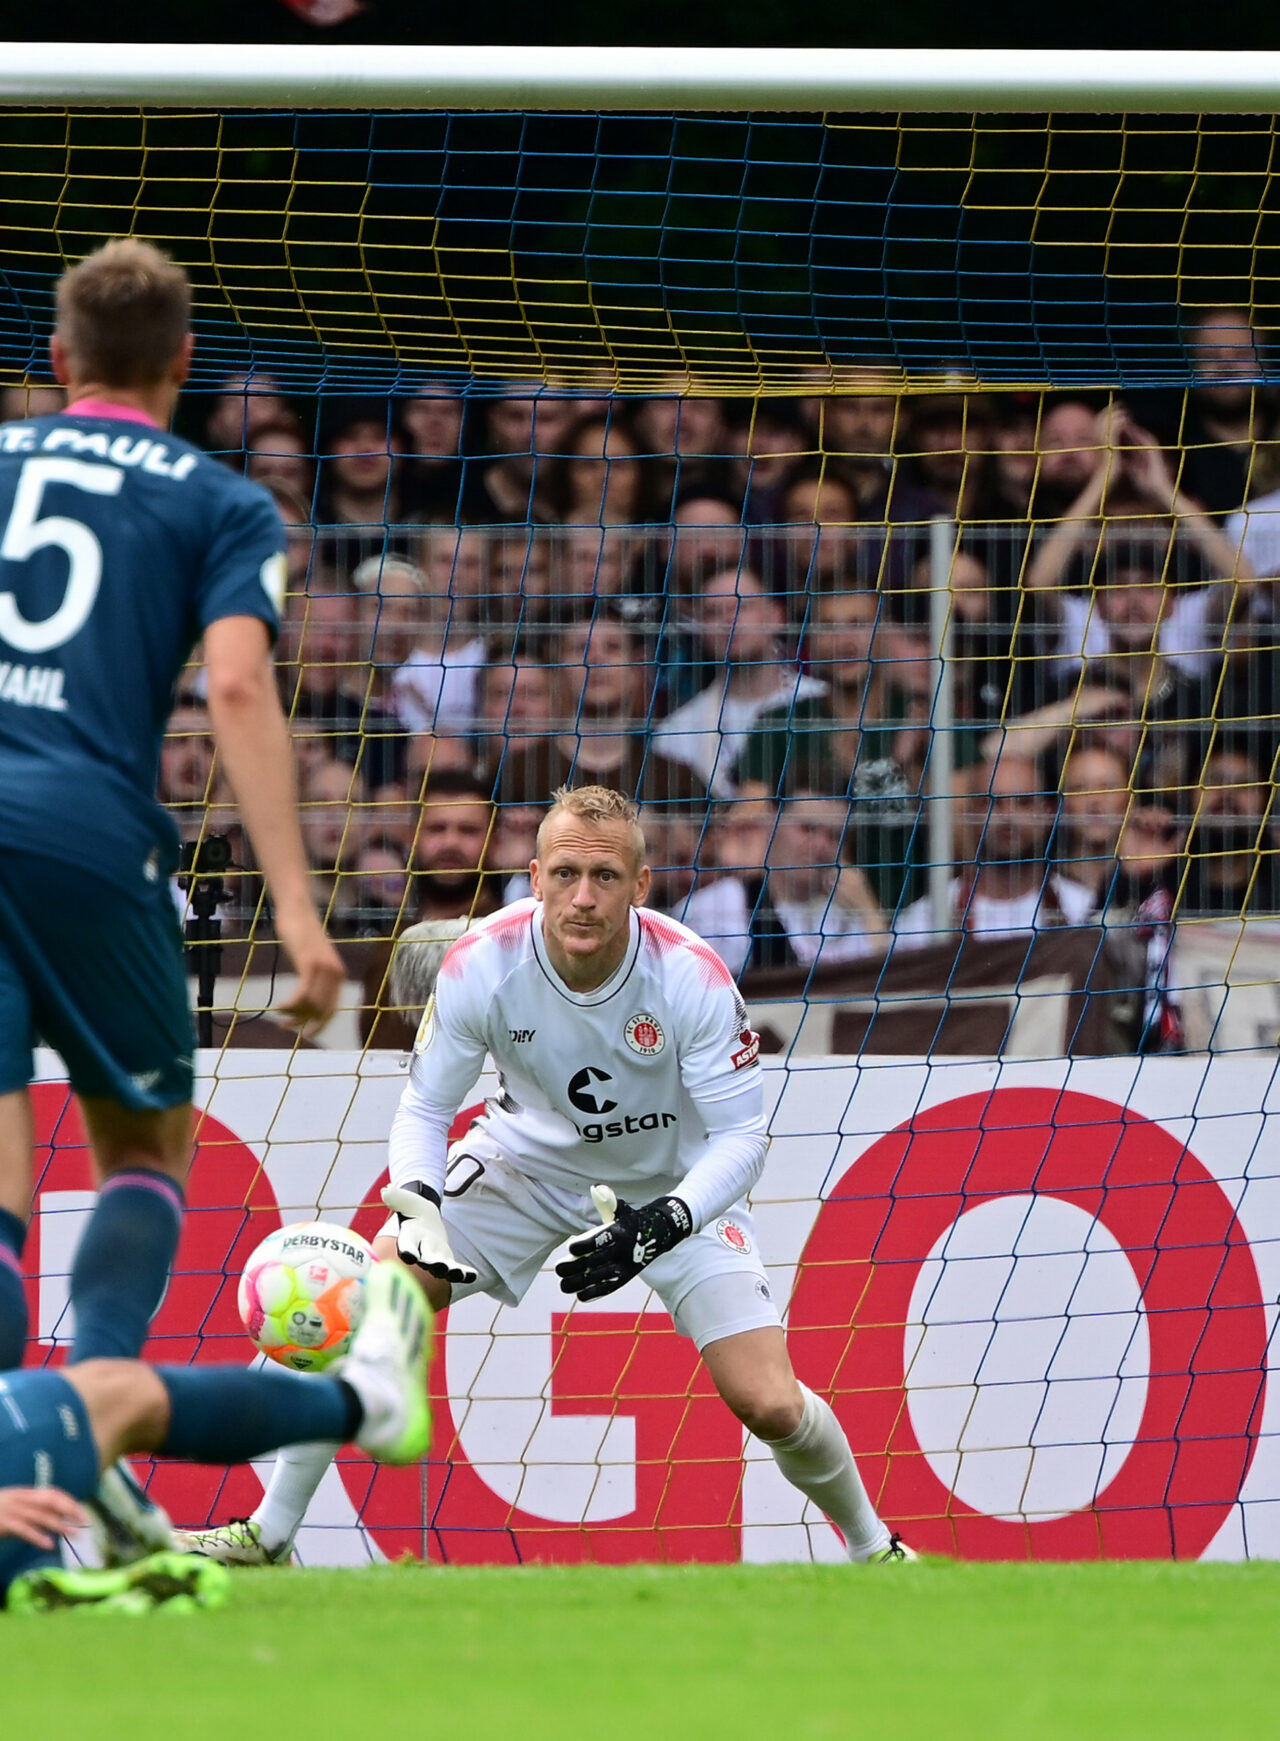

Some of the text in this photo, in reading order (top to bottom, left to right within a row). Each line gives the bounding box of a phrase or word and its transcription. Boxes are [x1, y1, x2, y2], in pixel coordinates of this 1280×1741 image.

[42, 428, 198, 481] PAULI
[572, 1112, 678, 1143] gstar
[283, 1235, 365, 1264] DERBYSTAR
